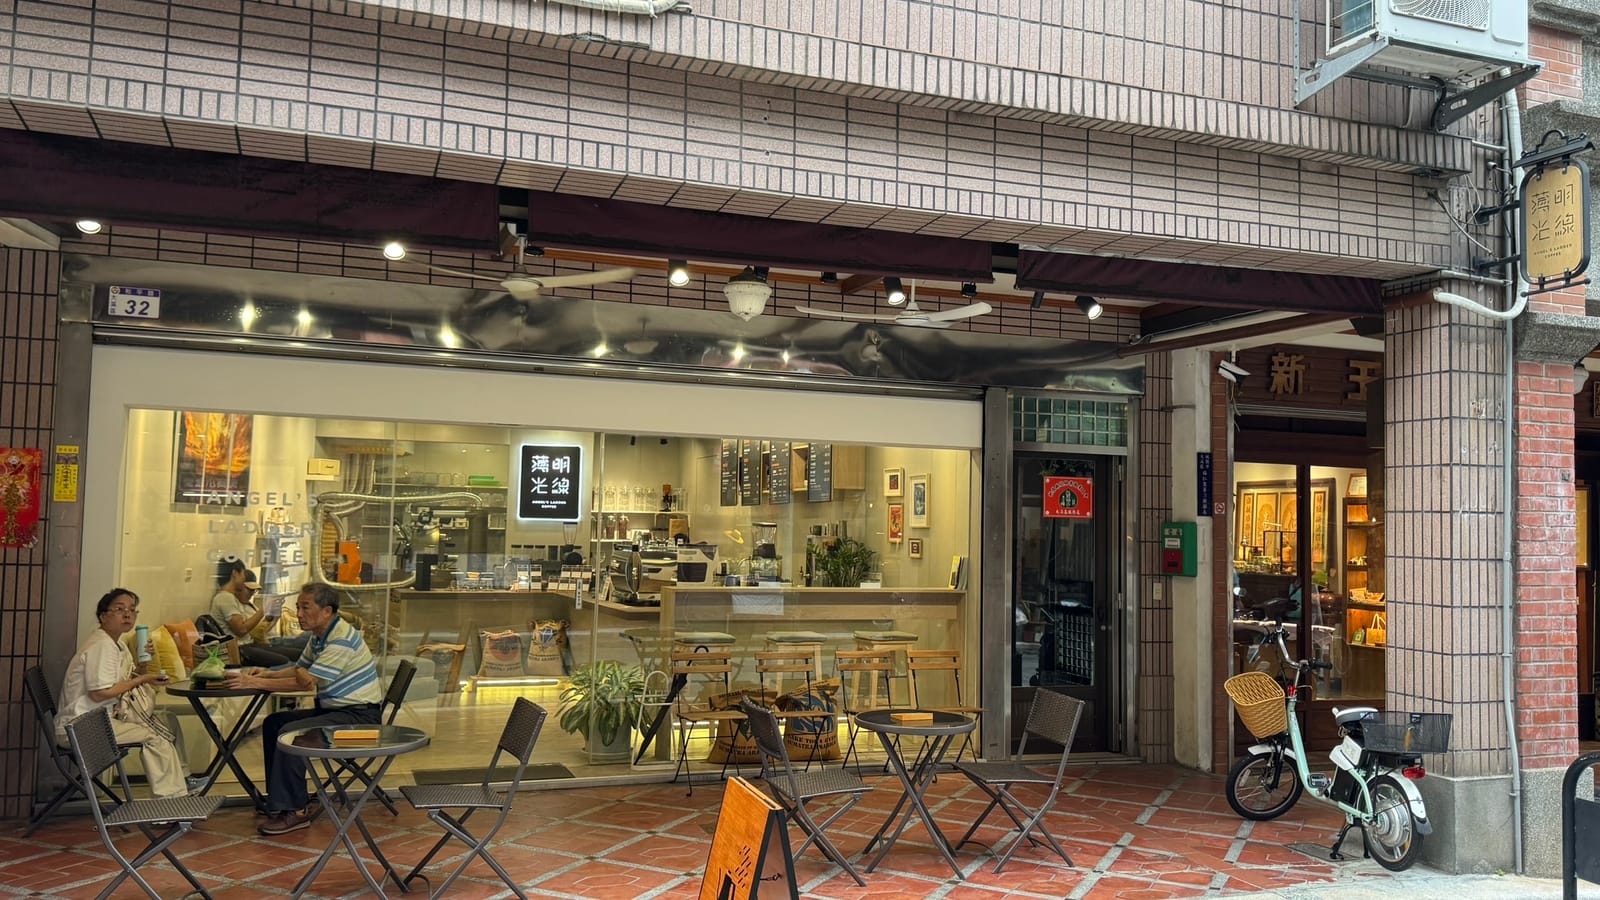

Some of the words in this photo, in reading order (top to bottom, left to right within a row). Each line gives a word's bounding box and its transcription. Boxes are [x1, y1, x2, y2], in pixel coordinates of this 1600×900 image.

[1531, 184, 1574, 215] 薄明
[124, 299, 150, 315] 32
[531, 454, 571, 474] 薄明
[206, 491, 318, 507] ANGEL'S
[208, 520, 318, 537] LADDER
[206, 548, 305, 564] COFFEE
